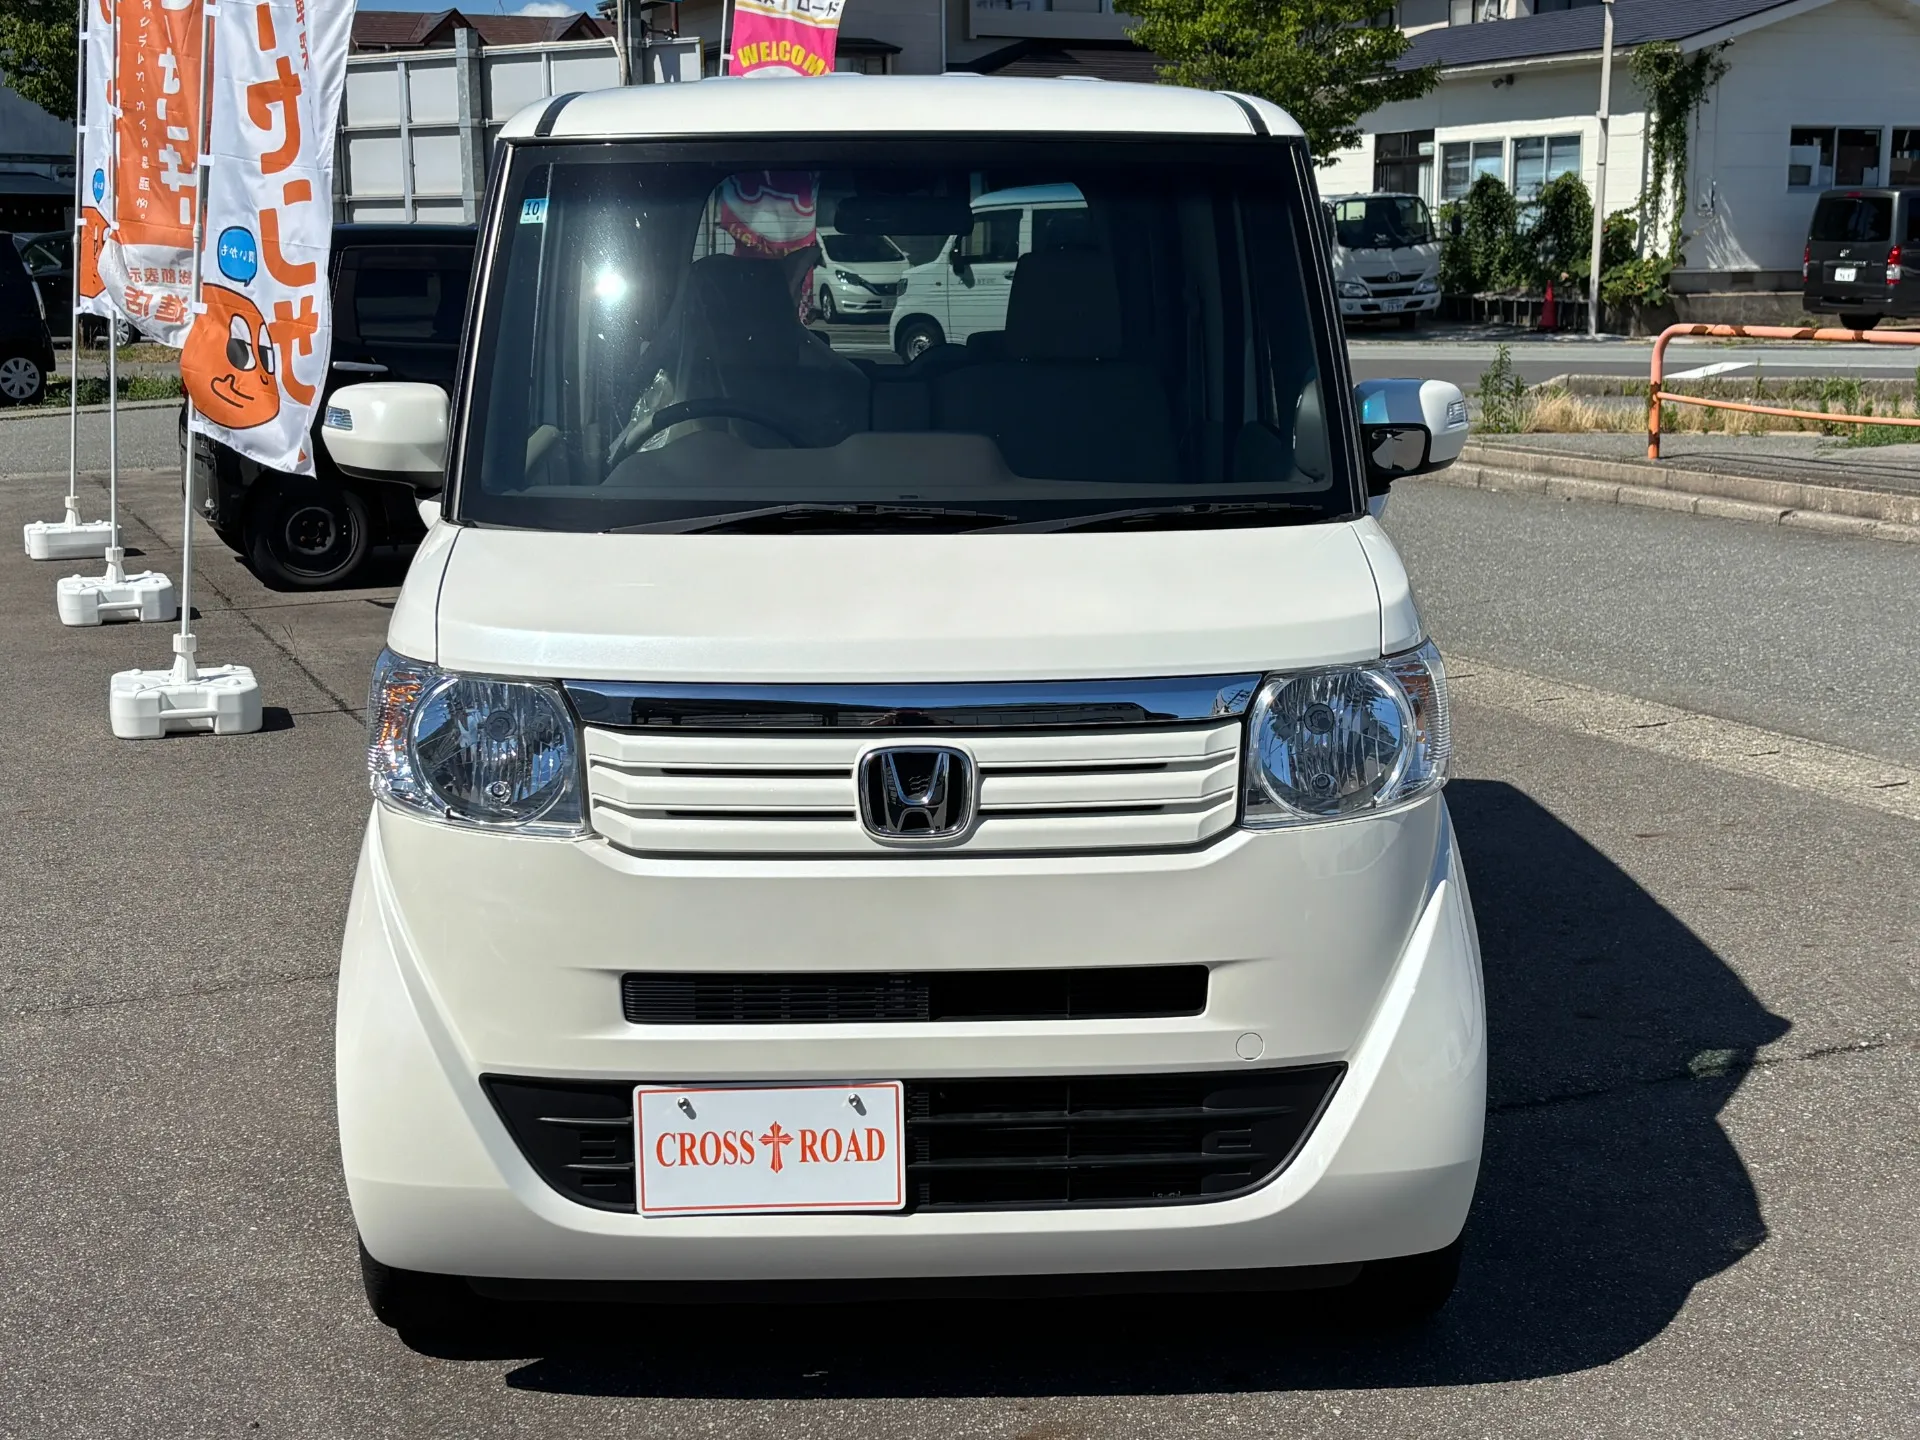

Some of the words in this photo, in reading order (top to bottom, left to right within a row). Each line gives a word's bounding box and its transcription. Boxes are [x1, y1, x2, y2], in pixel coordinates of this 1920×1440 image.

[525, 202, 540, 216] 10
[655, 1130, 756, 1168] CROSS
[798, 1127, 886, 1163] ROAD
